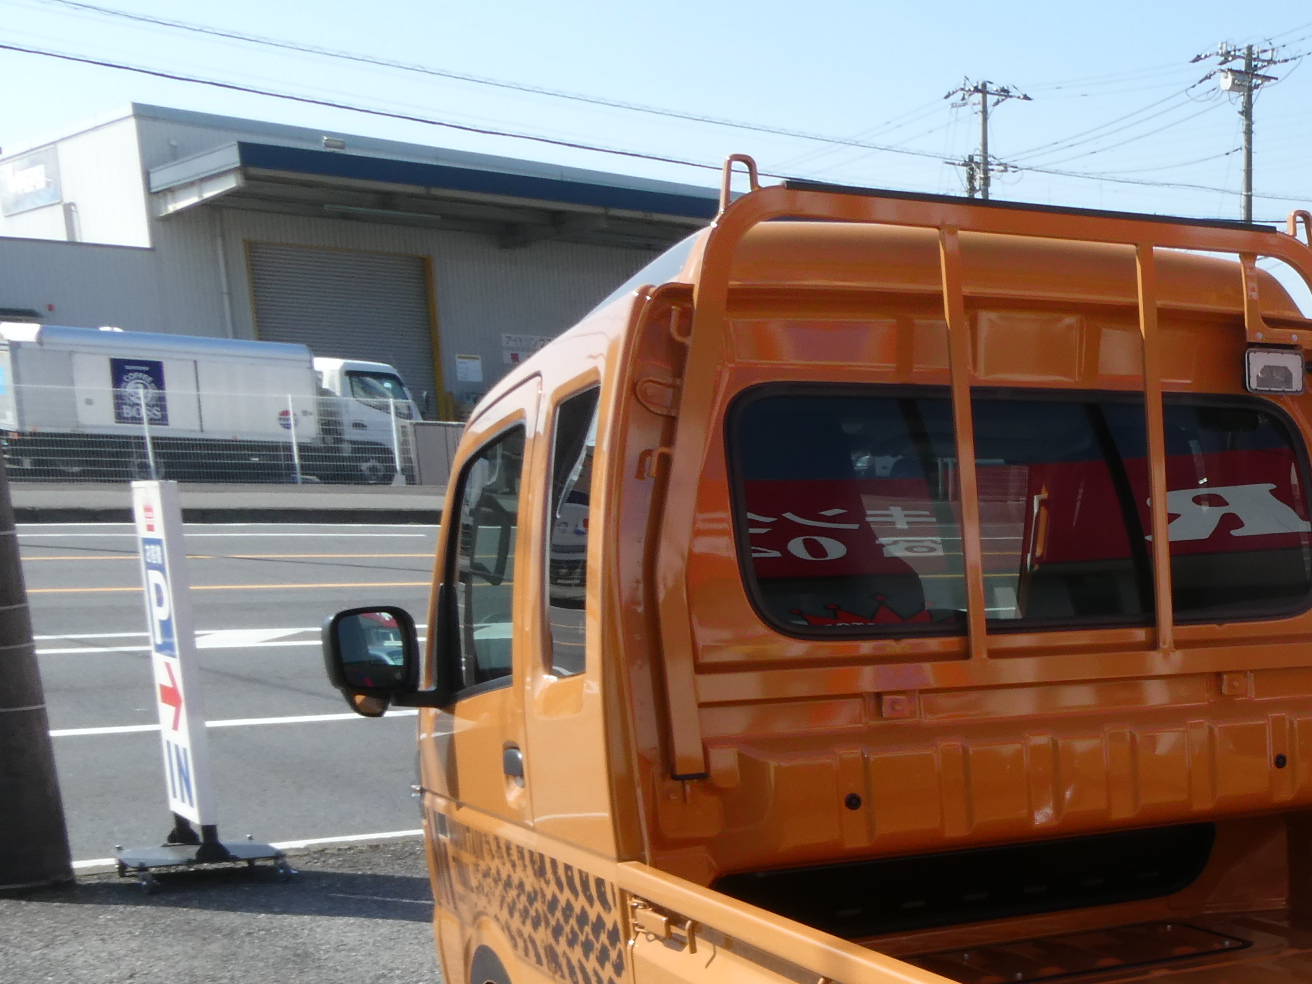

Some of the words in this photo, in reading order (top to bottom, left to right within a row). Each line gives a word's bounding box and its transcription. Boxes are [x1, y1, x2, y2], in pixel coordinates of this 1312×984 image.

[122, 404, 162, 419] BOSS
[147, 569, 170, 645] P
[166, 739, 194, 808] IN
